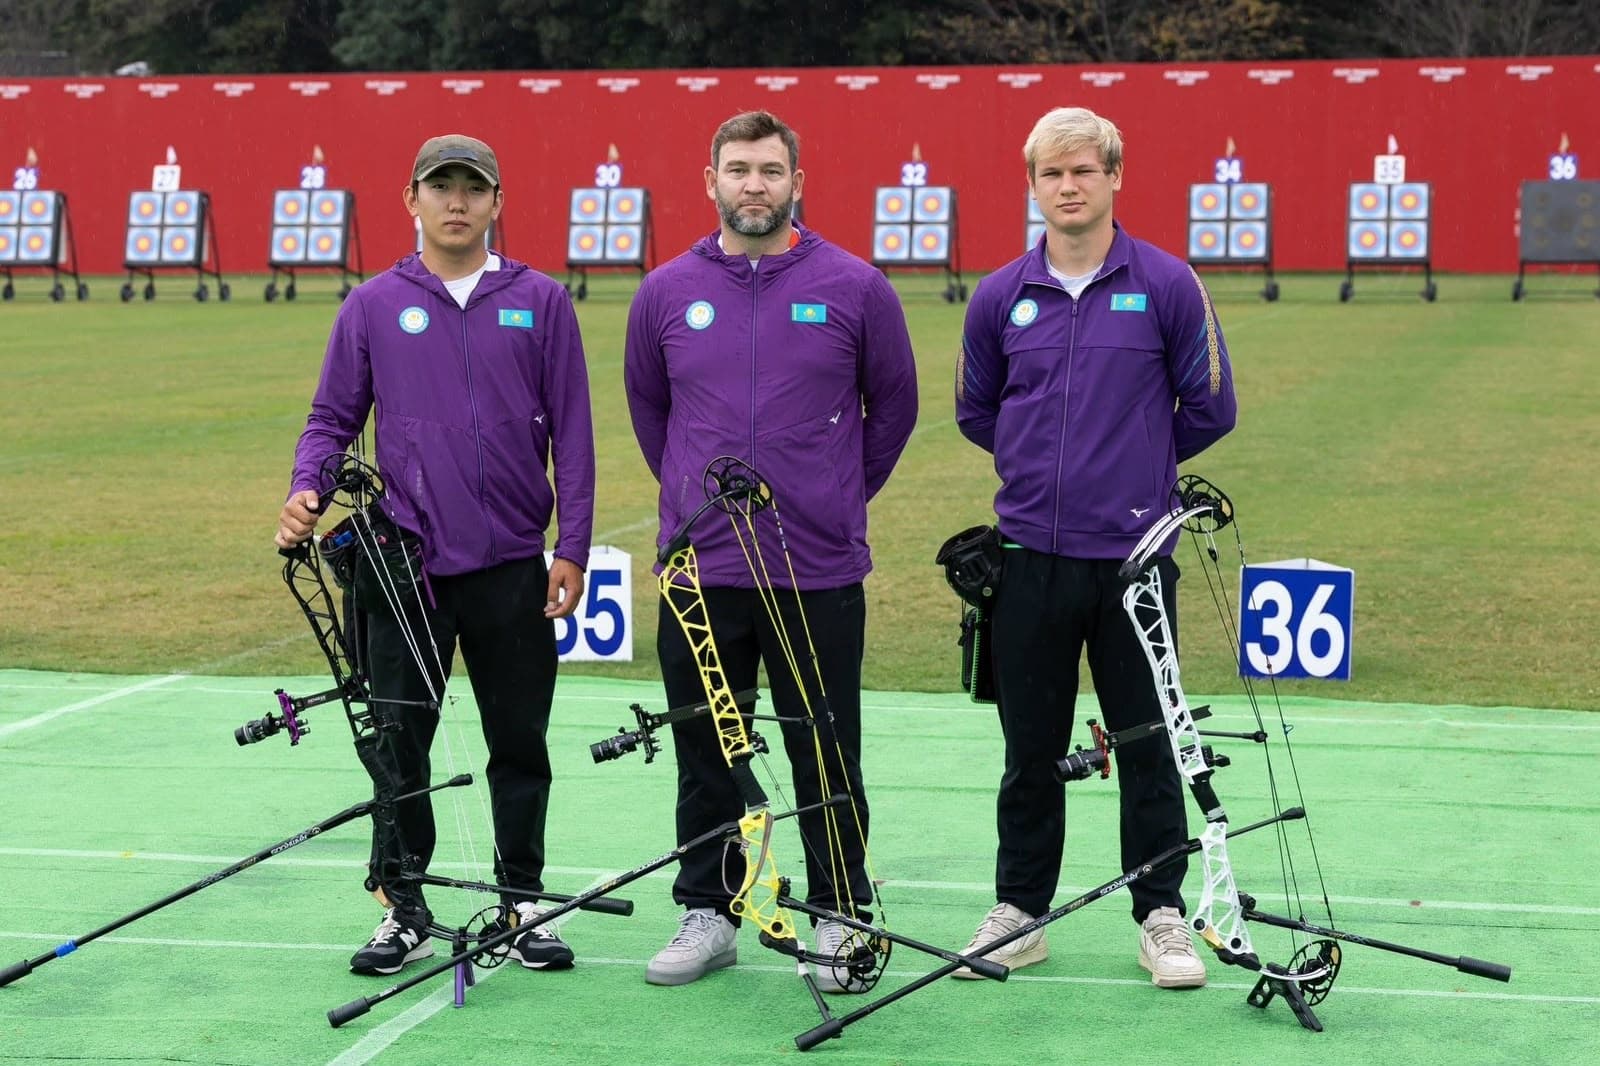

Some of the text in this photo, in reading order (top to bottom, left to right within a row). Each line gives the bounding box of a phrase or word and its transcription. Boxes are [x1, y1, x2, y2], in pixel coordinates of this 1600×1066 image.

[13, 167, 37, 190] 26
[300, 166, 324, 189] 28
[595, 164, 621, 187] 30
[901, 163, 927, 186] 32
[1216, 159, 1242, 182] 34
[1550, 155, 1577, 181] 36
[1246, 580, 1345, 677] 36
